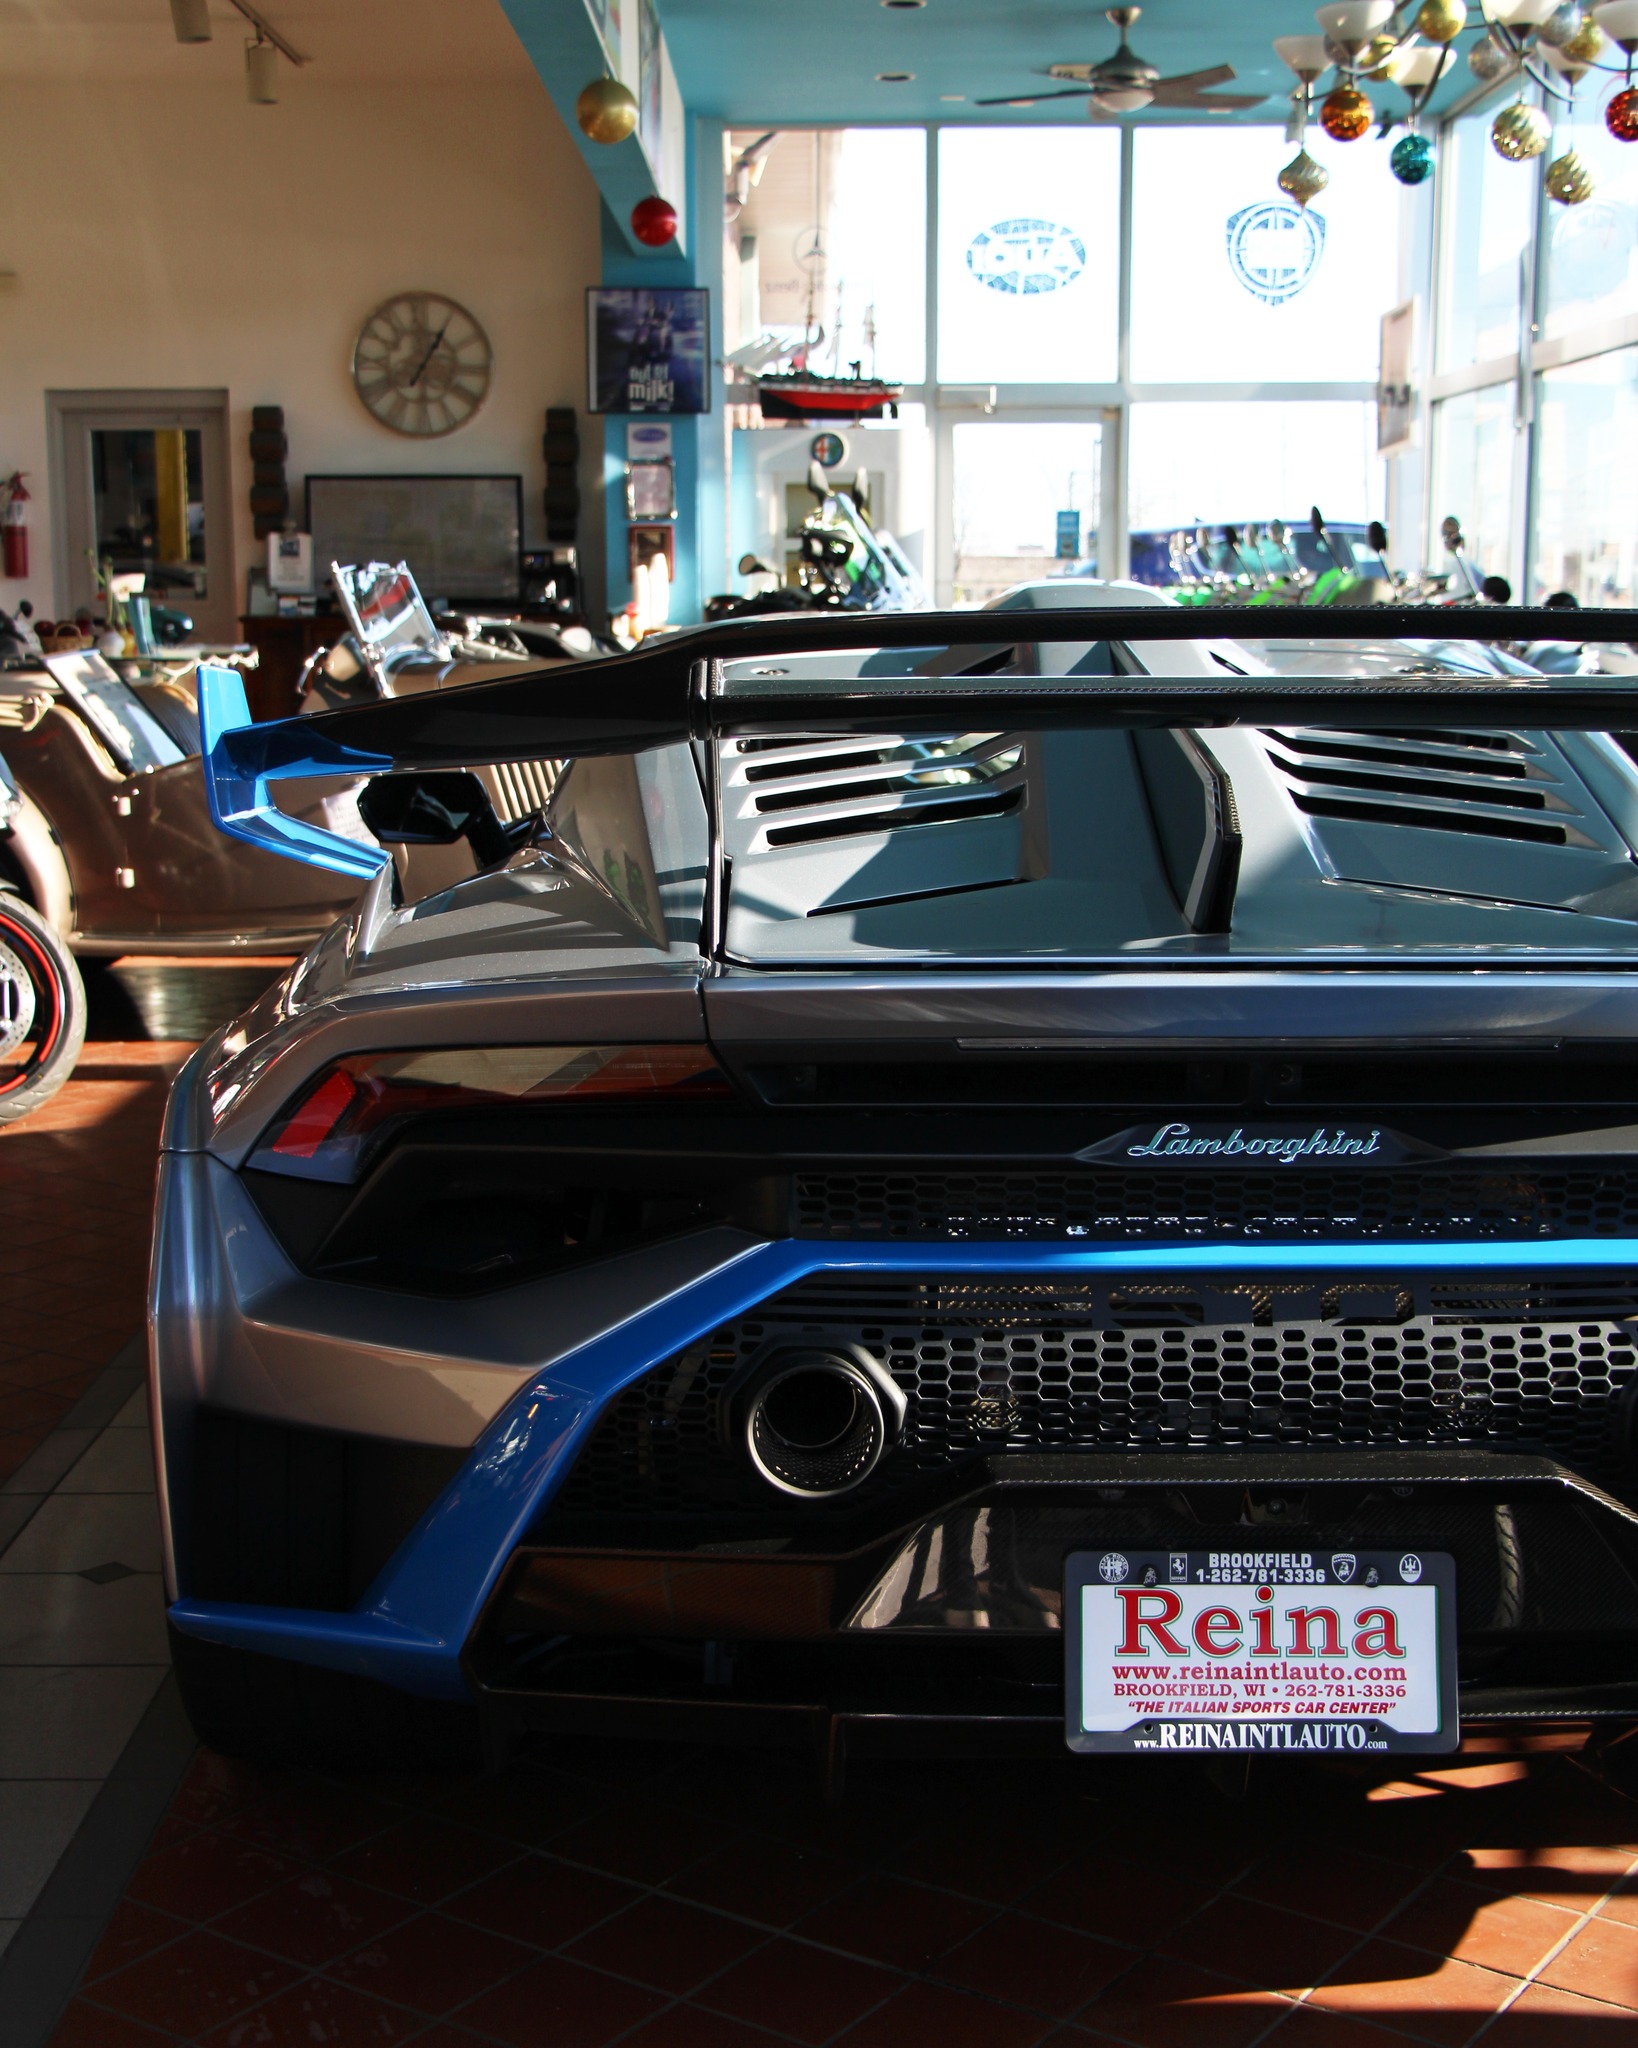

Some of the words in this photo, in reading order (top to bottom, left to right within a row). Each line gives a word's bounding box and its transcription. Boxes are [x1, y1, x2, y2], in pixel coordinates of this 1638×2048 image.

[1127, 1123, 1381, 1163] Lamborghini
[1209, 1553, 1312, 1568] BROOKFIELD
[1196, 1568, 1326, 1583] 1-262-781-3336
[1114, 1584, 1407, 1659] Reina
[1112, 1661, 1407, 1681] www.reinaintlauto.com
[1113, 1683, 1238, 1699] BROOKFIELD,
[1244, 1683, 1266, 1697] WI
[1284, 1683, 1407, 1698] 262-781-3336
[1128, 1701, 1165, 1713] “THE
[1168, 1701, 1229, 1713] ITALIAN
[1231, 1701, 1291, 1714] SPORTS
[1294, 1701, 1326, 1714] CAR
[1328, 1701, 1397, 1714] CENTER”
[1133, 1722, 1388, 1749] www.REINAINTLAUTO.com
